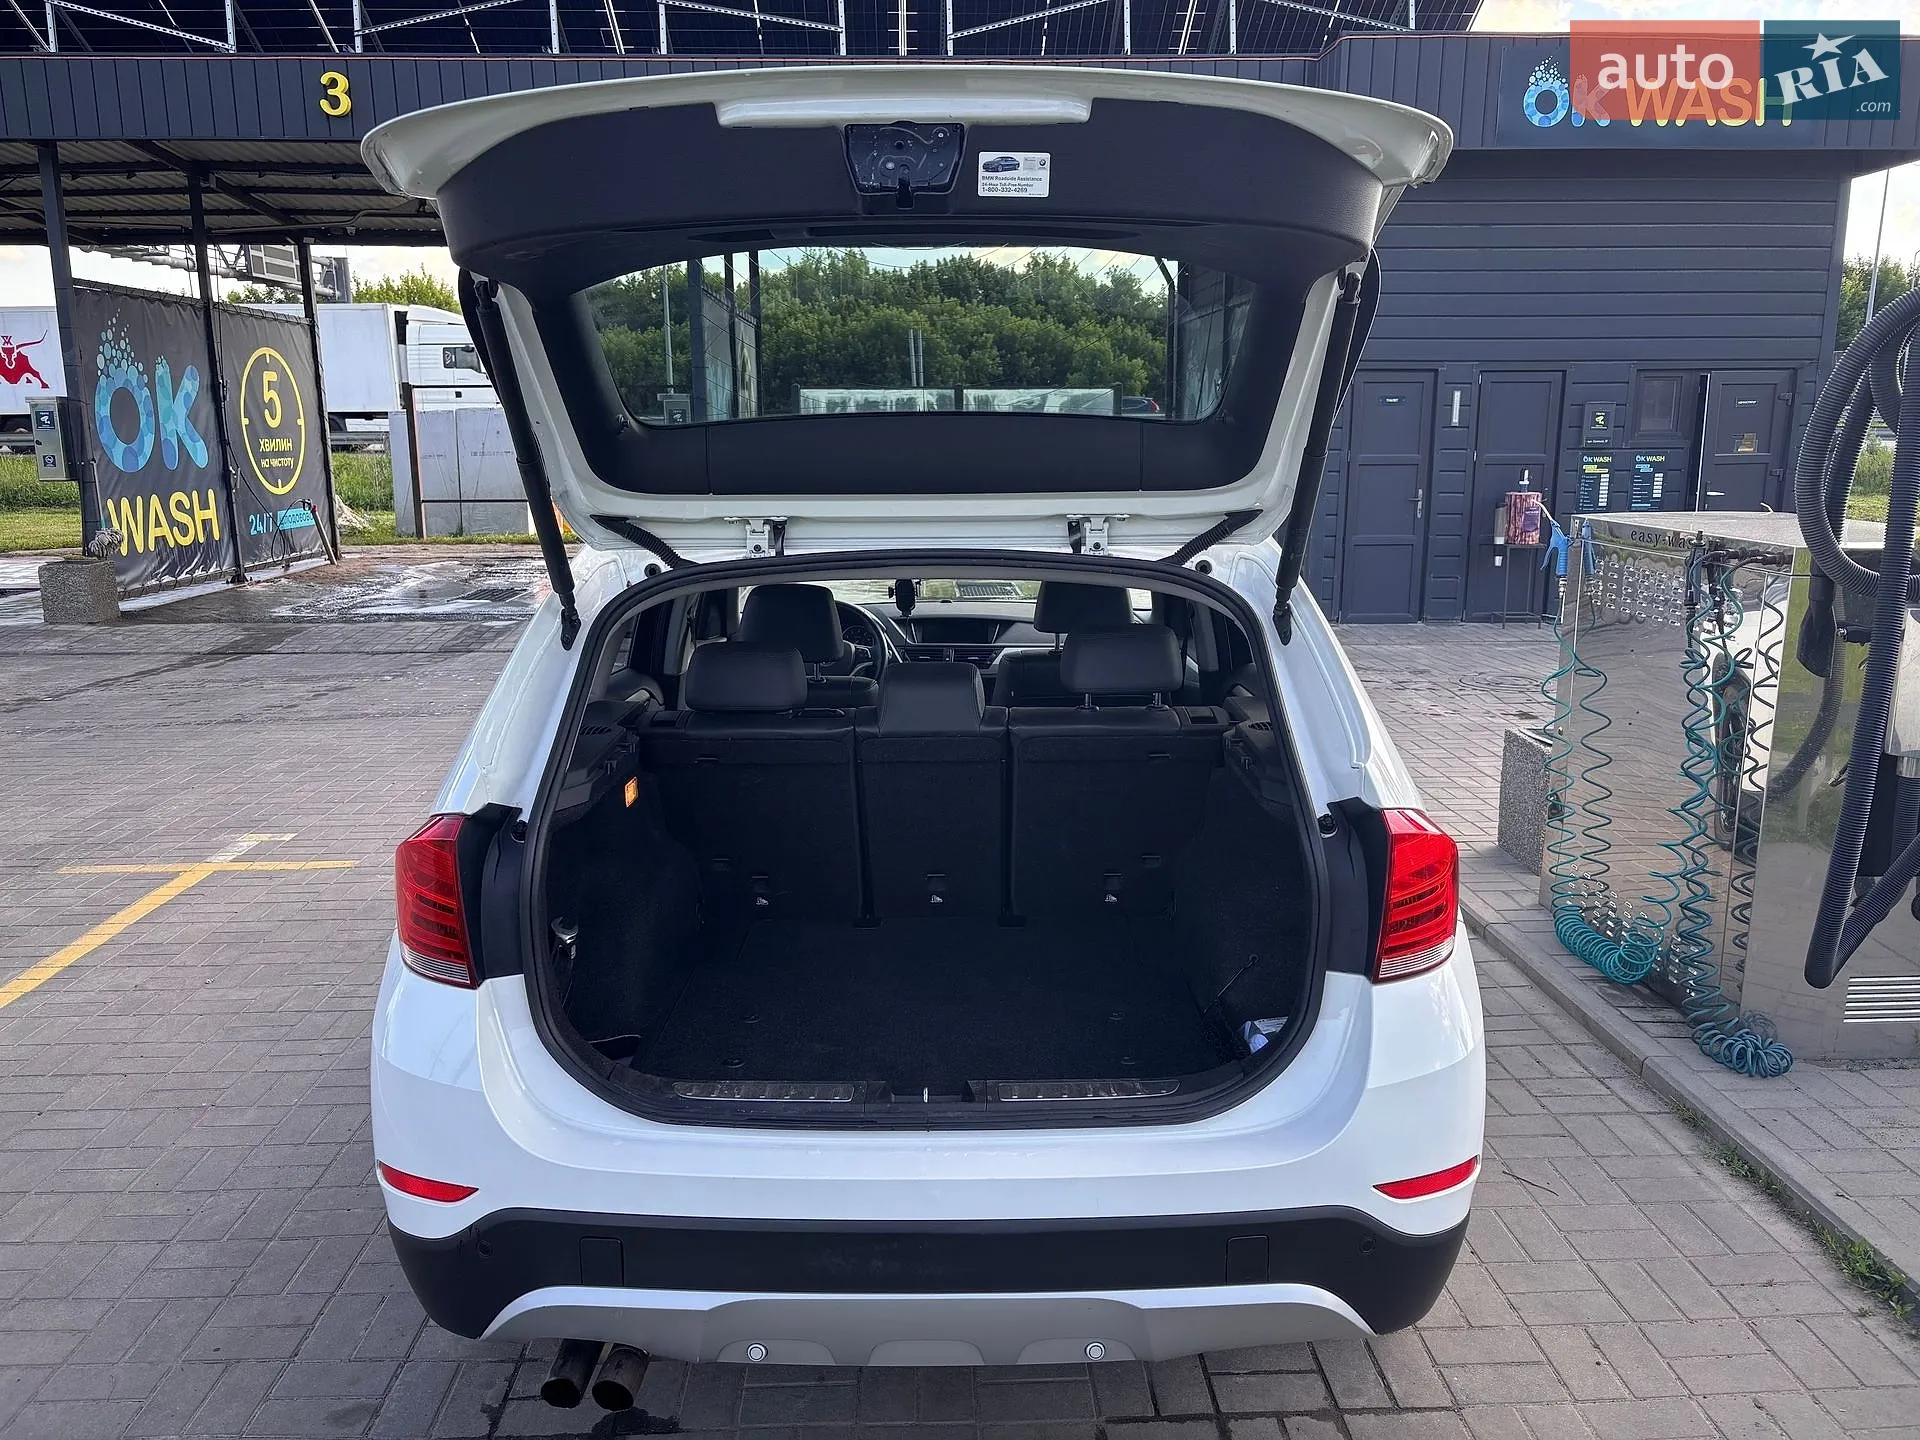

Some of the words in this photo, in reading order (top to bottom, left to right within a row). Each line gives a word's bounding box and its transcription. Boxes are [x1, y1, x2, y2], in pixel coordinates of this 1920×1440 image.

[320, 71, 352, 116] 3
[1523, 69, 1611, 127] OK
[1626, 77, 1793, 127] WASH
[95, 354, 209, 473] OK
[263, 371, 281, 428] 5
[259, 438, 293, 452] ХВИЛИН
[106, 488, 220, 556] WASH
